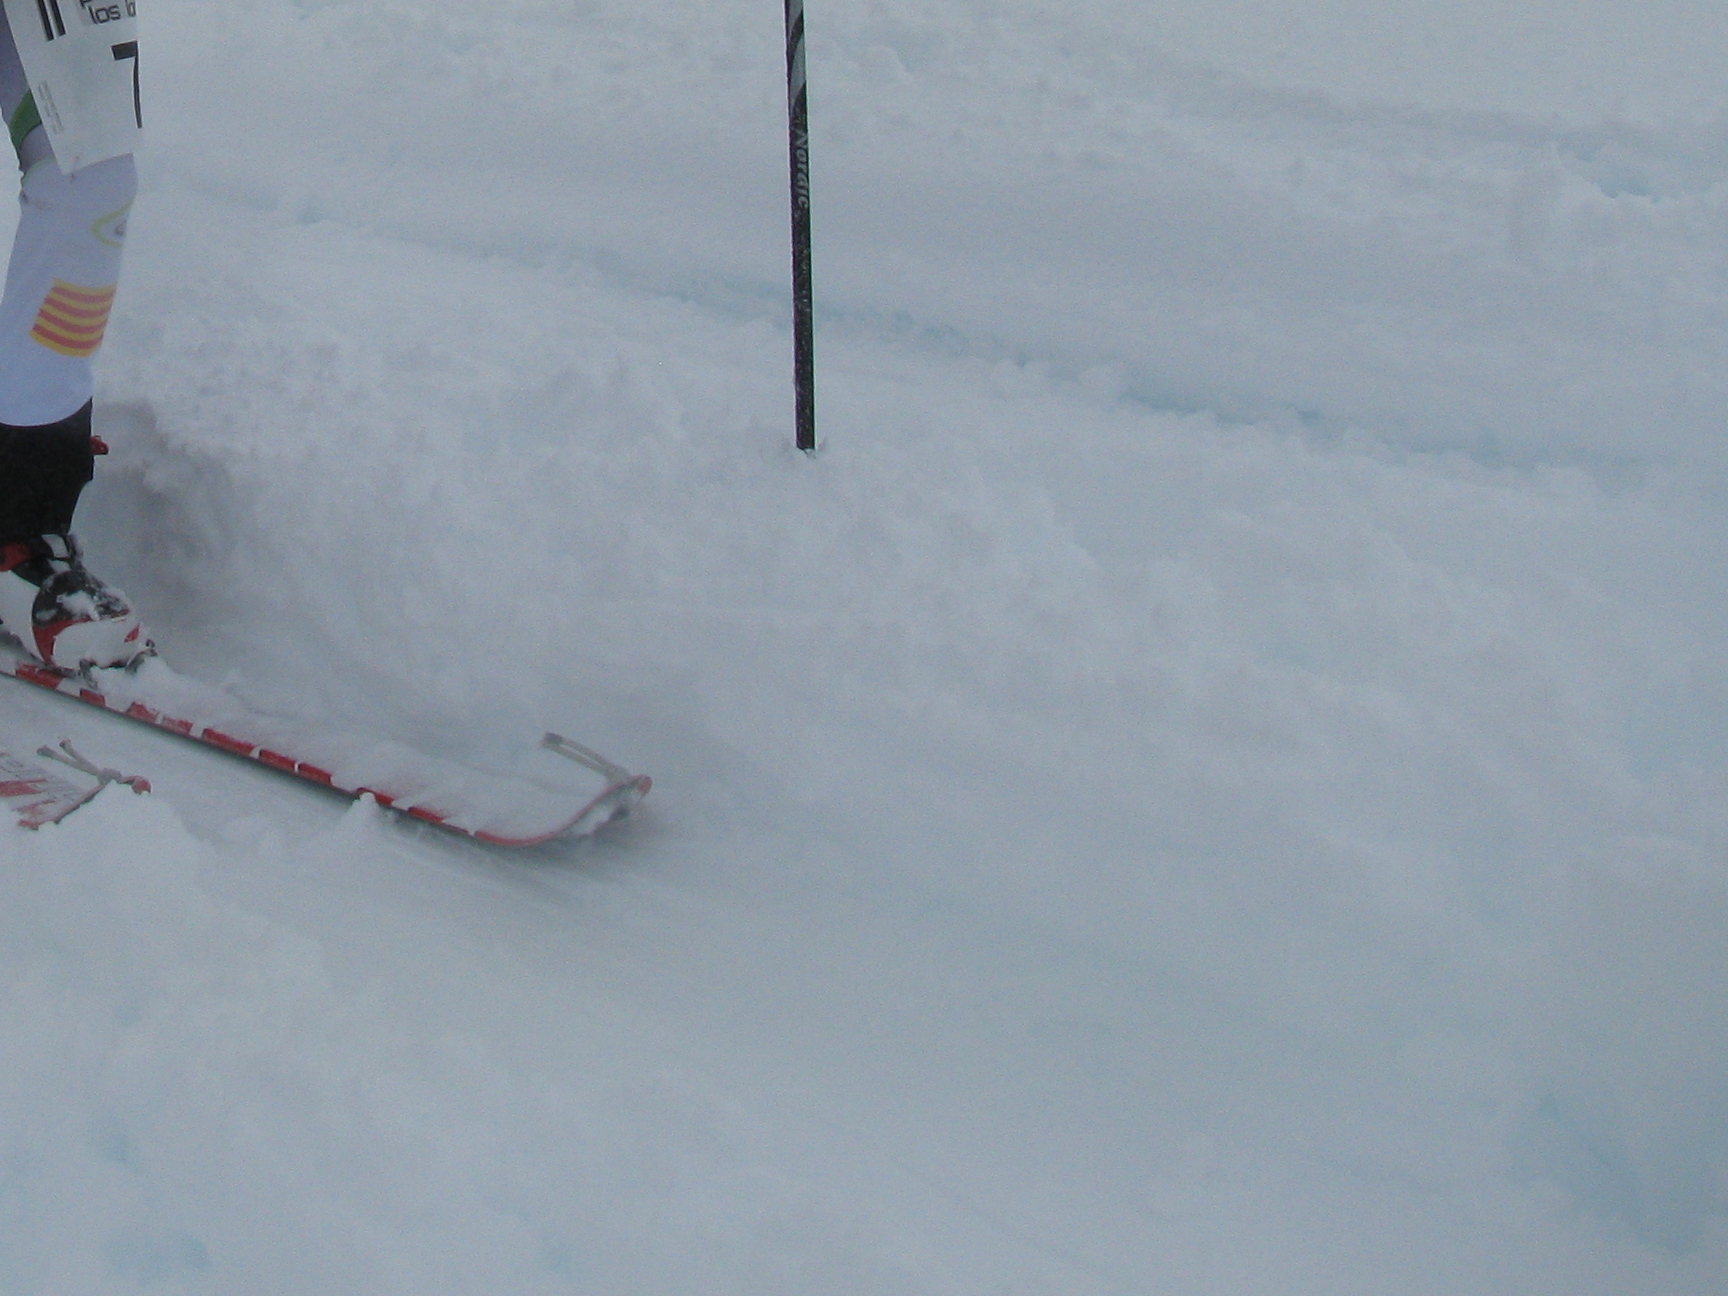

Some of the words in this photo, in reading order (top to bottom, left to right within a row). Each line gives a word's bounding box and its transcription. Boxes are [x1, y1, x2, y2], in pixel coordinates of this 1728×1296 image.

[87, 4, 121, 25] los
[111, 40, 143, 129] 7
[794, 127, 809, 209] Nordic
